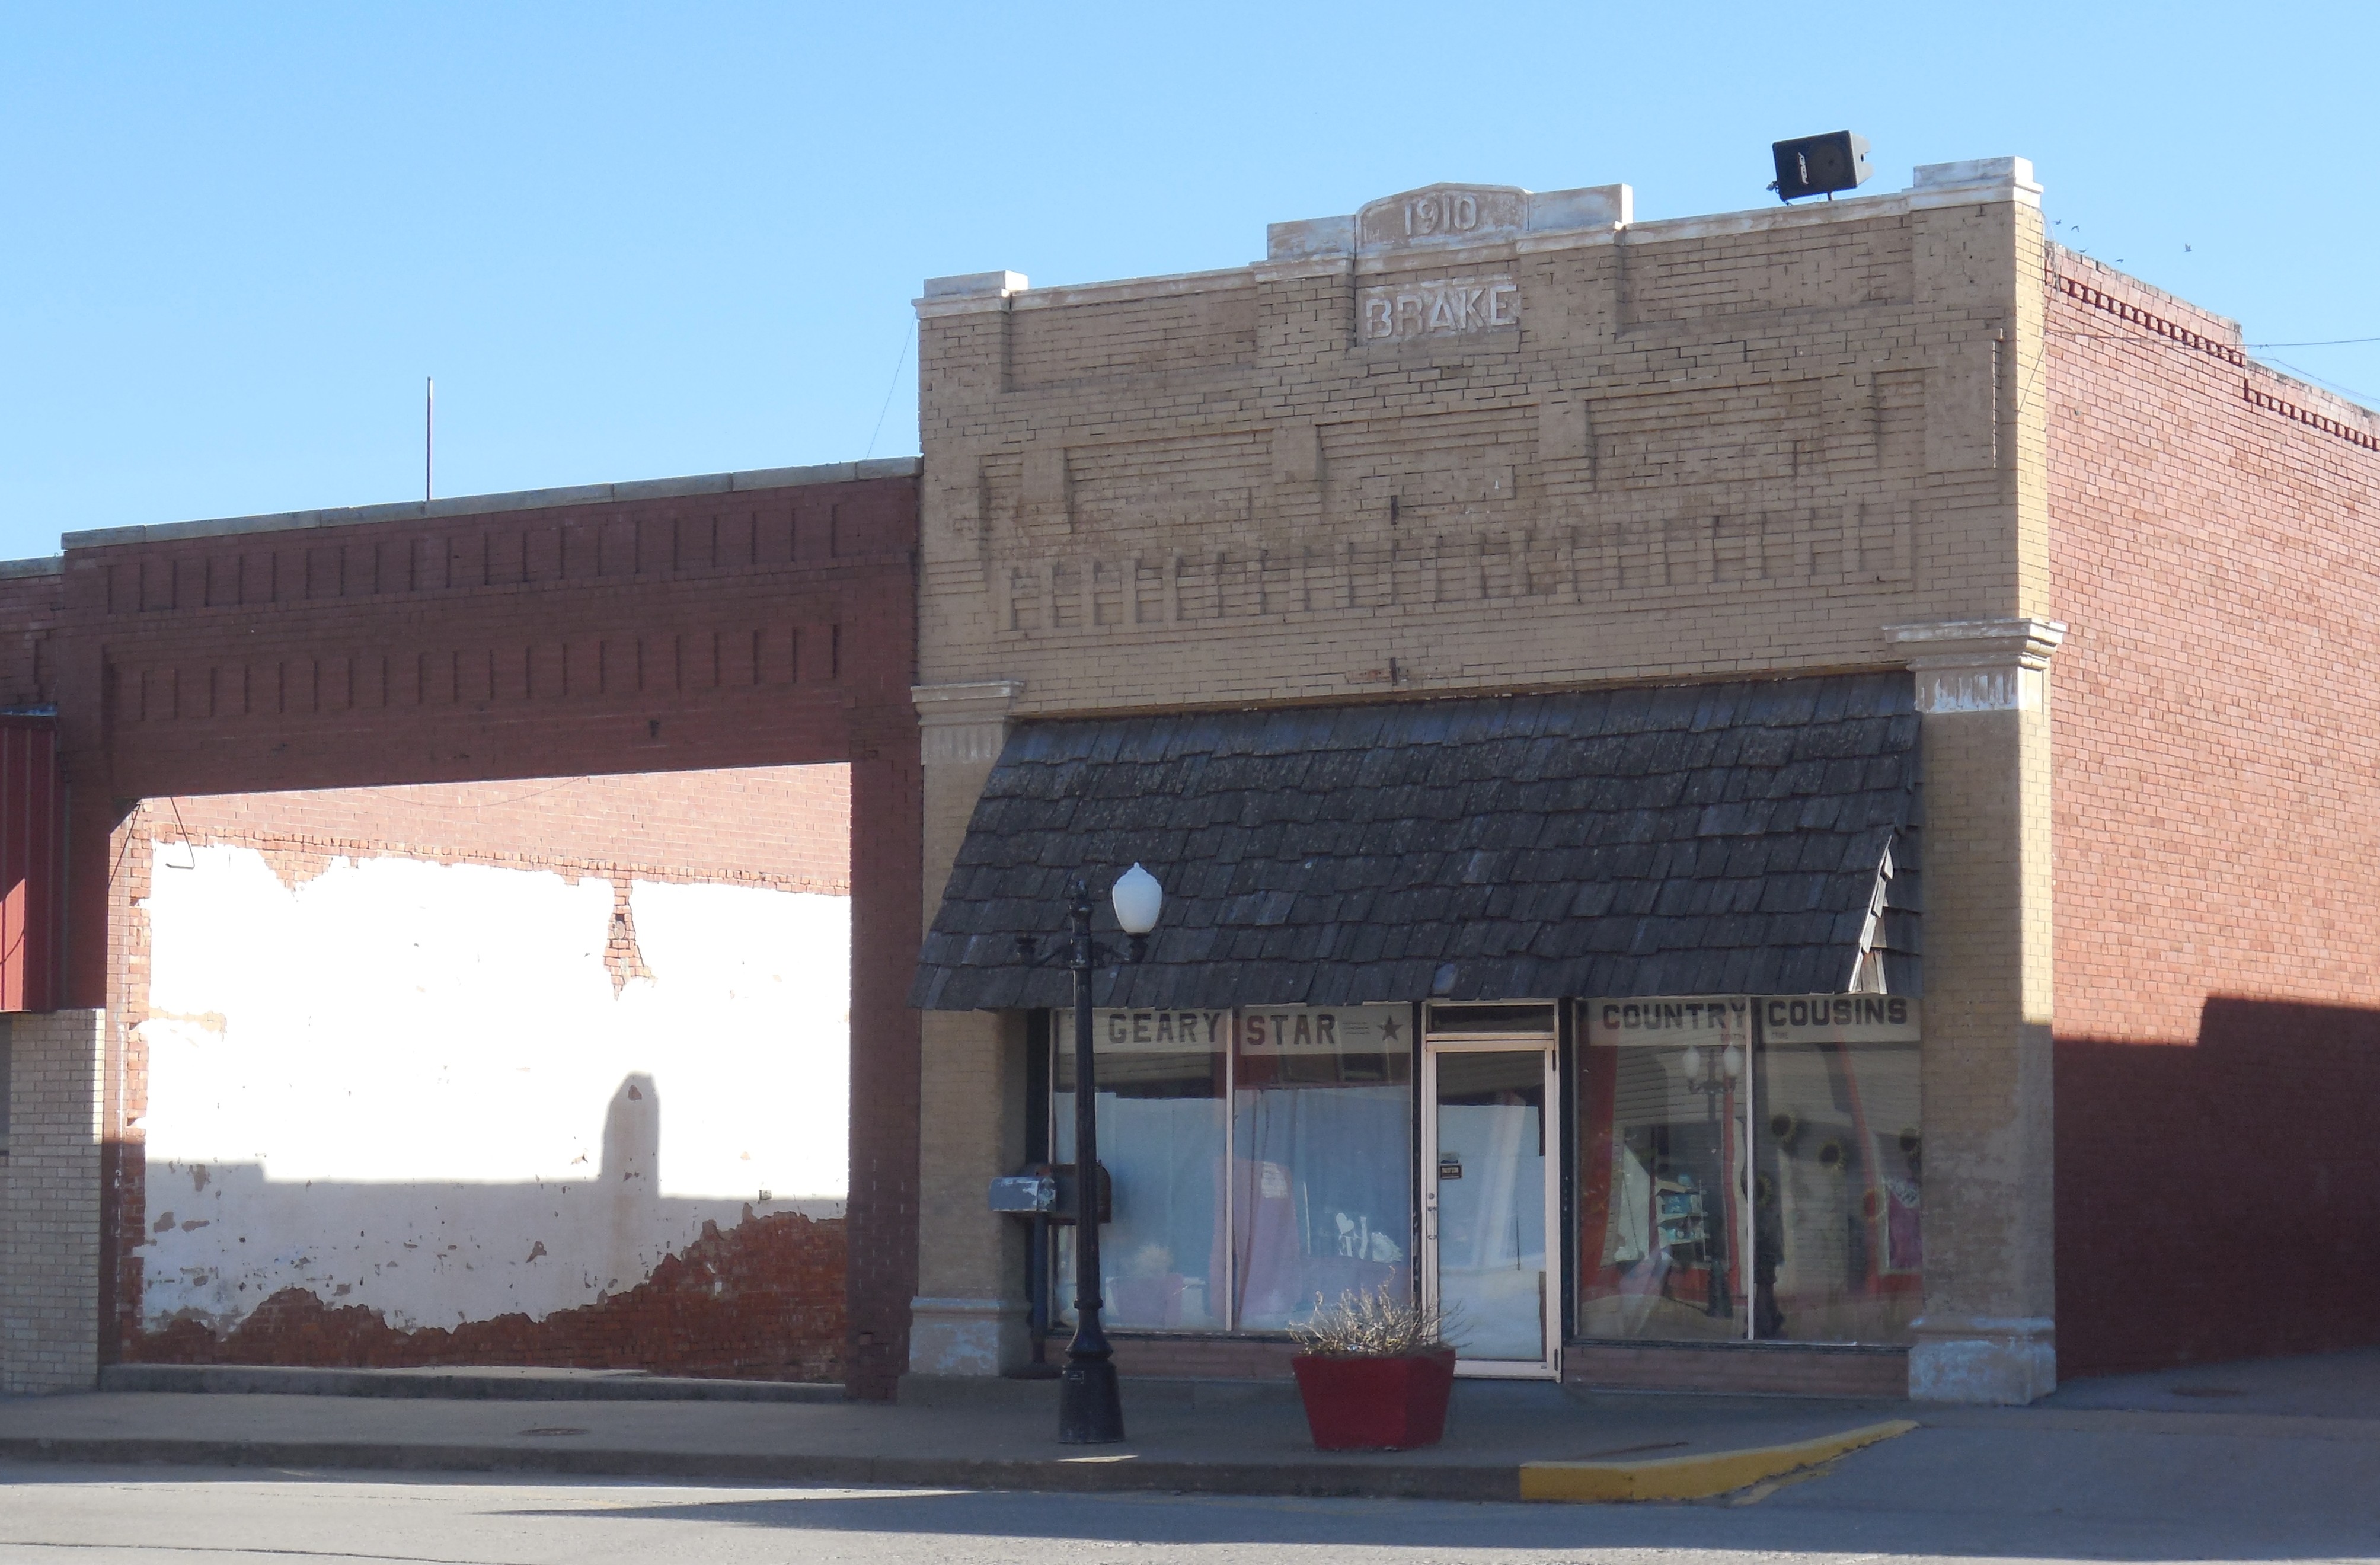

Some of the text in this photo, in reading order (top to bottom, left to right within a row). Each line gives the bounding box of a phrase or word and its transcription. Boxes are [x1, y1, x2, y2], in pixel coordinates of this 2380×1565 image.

[1404, 194, 1477, 235] 1910
[1366, 285, 1518, 338] BRAKE
[1108, 1013, 1335, 1046] GEARY STAR
[1602, 998, 1908, 1030] COUNTRY COUSINS
